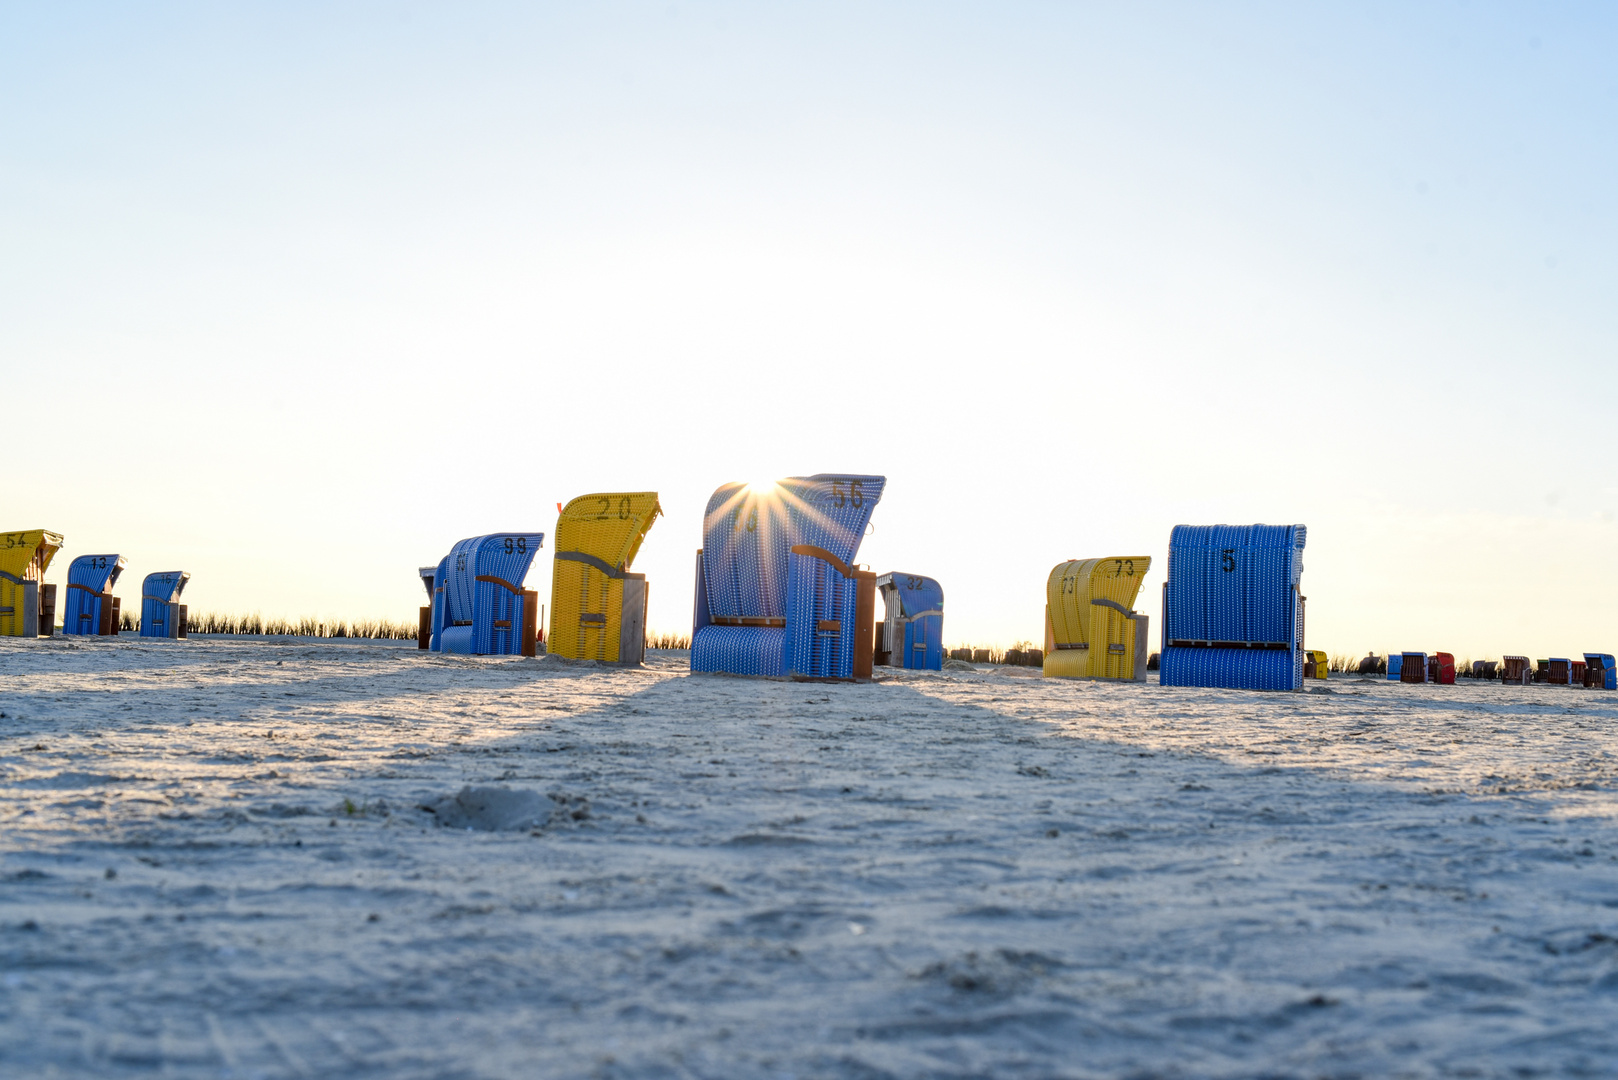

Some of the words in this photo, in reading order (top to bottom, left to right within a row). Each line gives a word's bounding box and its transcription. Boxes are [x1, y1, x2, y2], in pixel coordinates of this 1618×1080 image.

[832, 480, 864, 509] 56
[597, 497, 631, 520] 20
[7, 533, 26, 549] 54
[504, 537, 527, 555] 99
[91, 557, 107, 570] 13
[1115, 560, 1135, 578] 73
[1223, 549, 1235, 572] 5
[907, 576, 924, 591] 32
